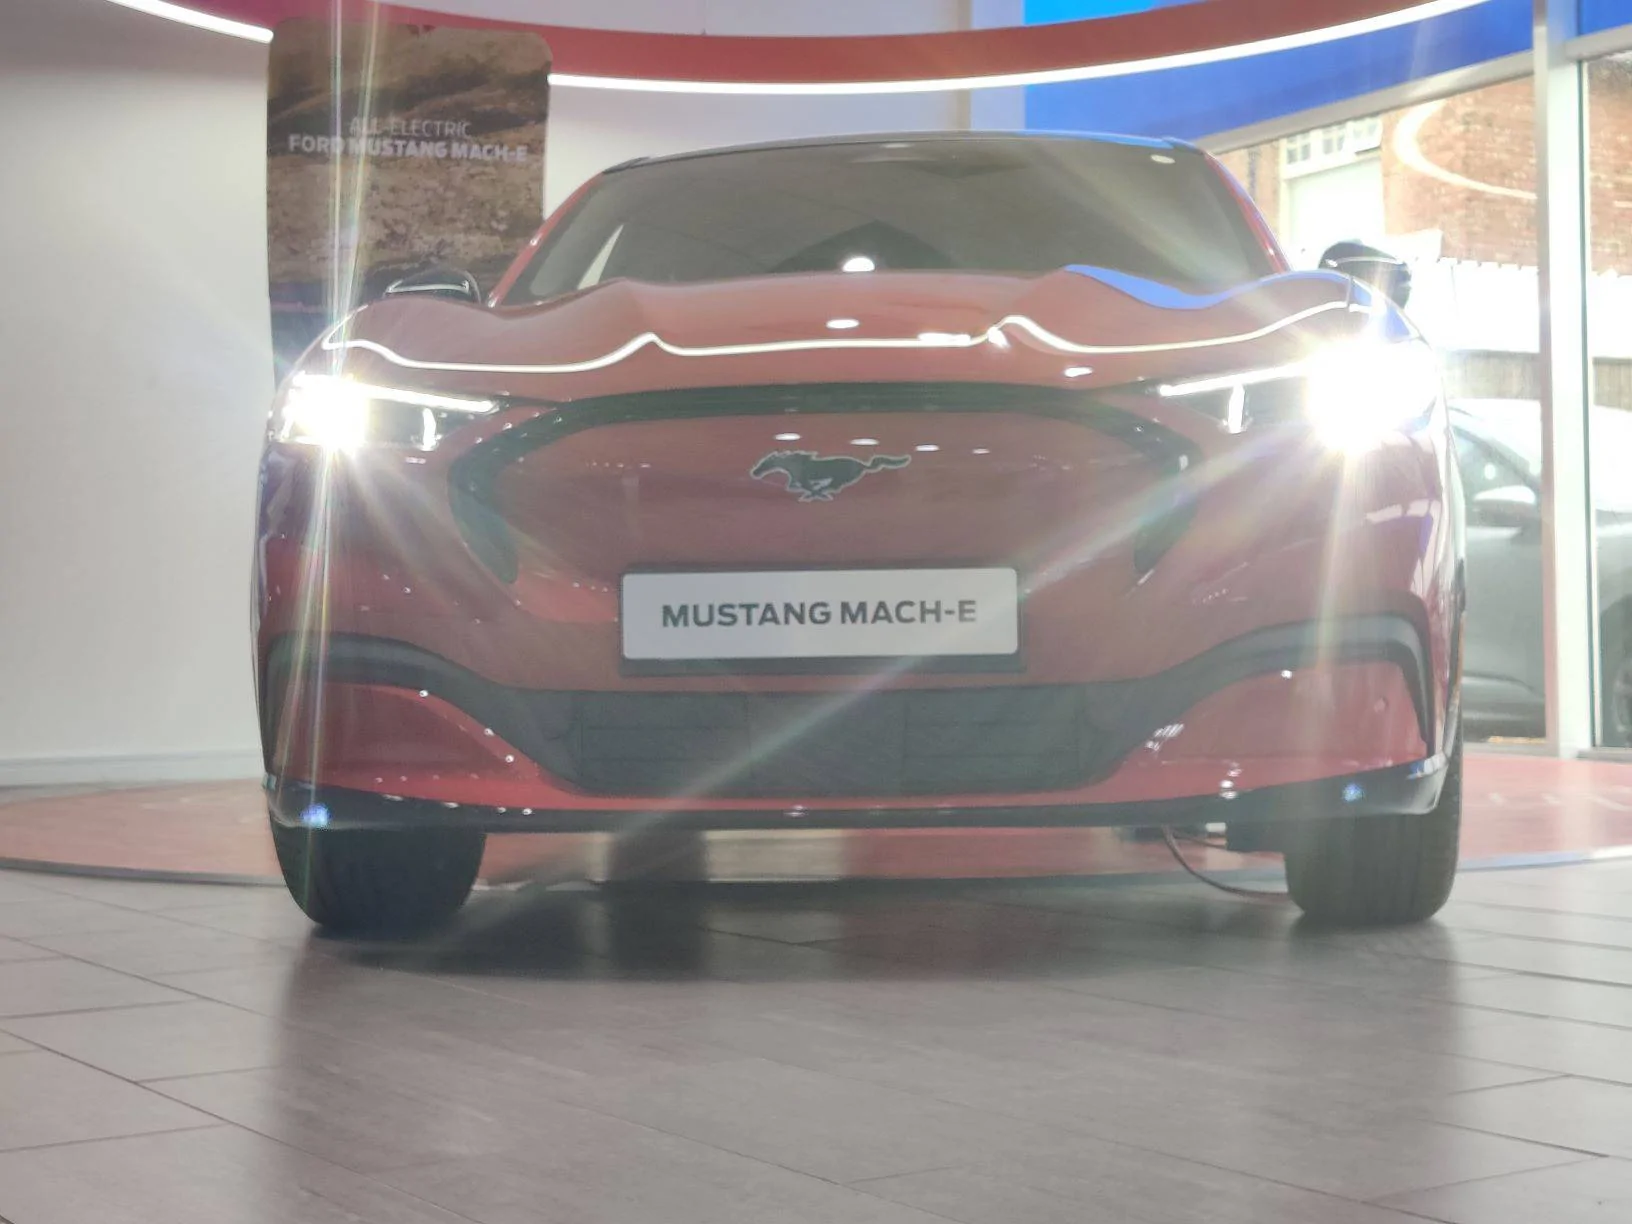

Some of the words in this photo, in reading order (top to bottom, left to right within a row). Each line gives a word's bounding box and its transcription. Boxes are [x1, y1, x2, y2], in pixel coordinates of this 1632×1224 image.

[349, 116, 472, 139] ALL-ELECTRIC
[288, 134, 346, 153] FORD
[348, 137, 448, 158] MUSTANG
[450, 142, 528, 162] MACH-E
[662, 601, 831, 628] MUSTANG
[840, 599, 977, 625] MACH-E
